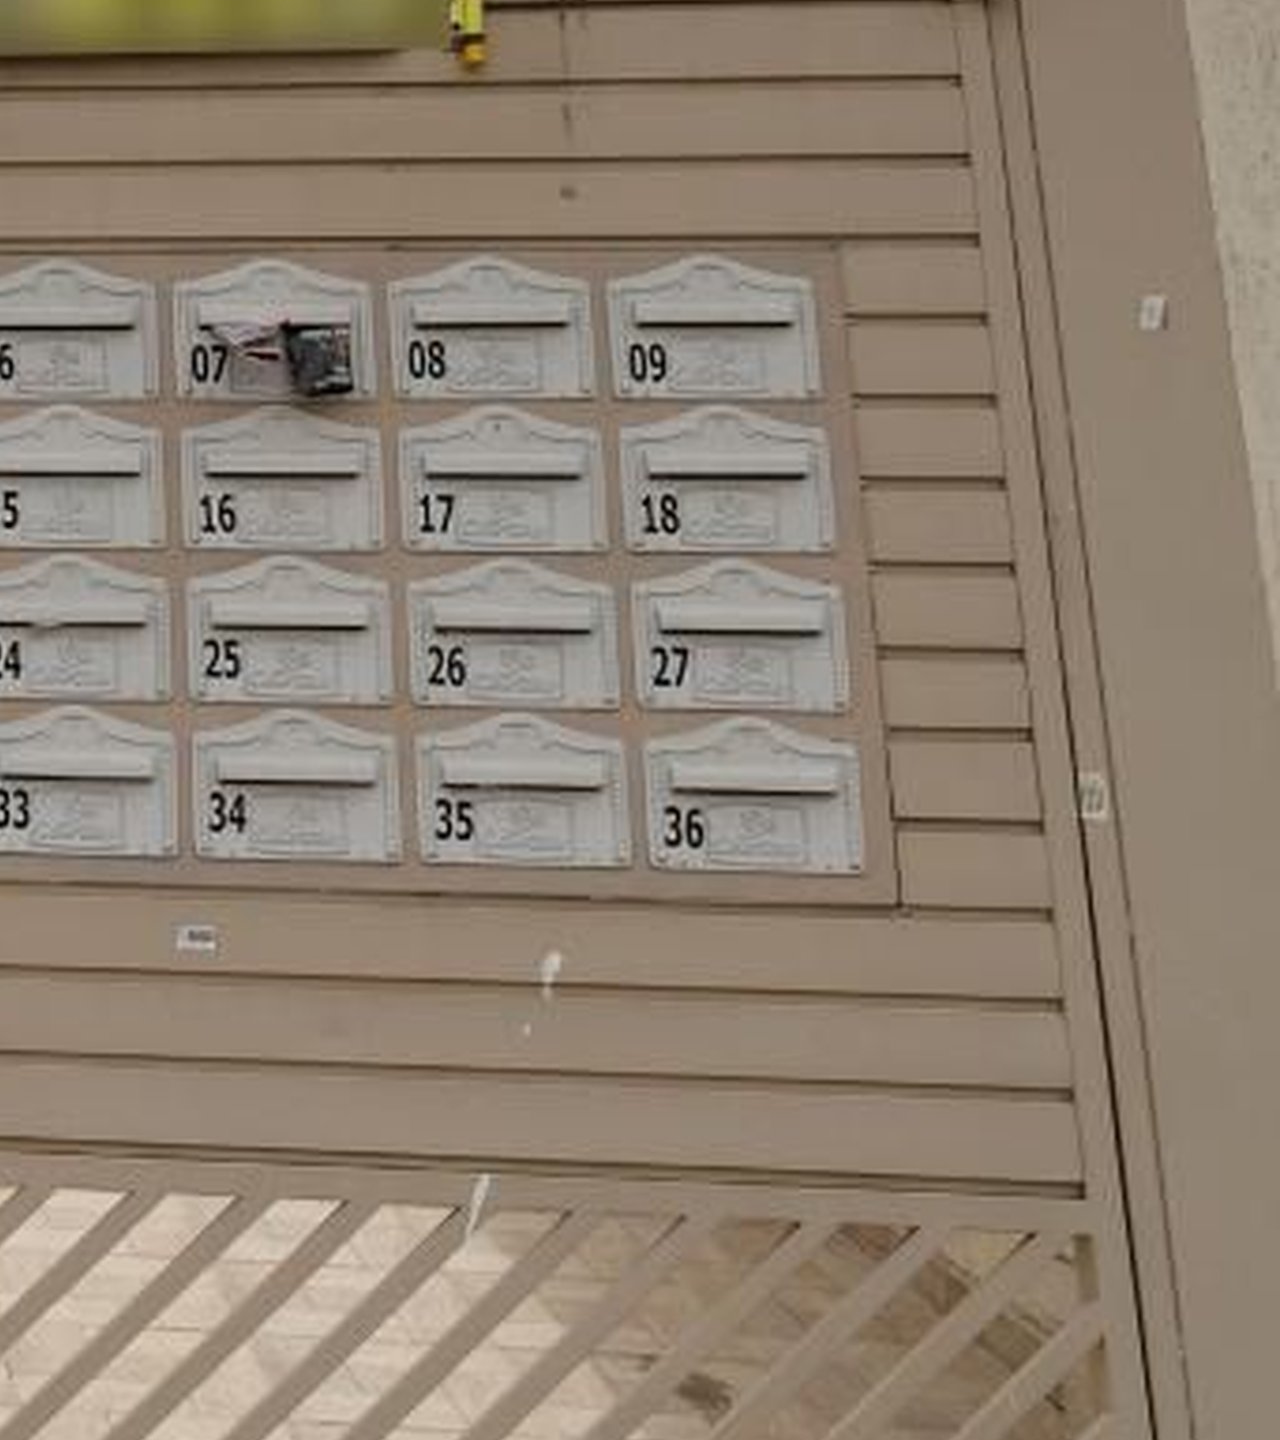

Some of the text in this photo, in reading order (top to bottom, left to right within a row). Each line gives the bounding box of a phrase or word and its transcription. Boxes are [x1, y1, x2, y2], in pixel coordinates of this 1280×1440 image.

[191, 344, 228, 384] 07
[408, 340, 447, 380] 08
[628, 343, 667, 383] 09
[199, 493, 237, 534] 16
[419, 494, 455, 533] 17
[641, 493, 681, 535] 18
[203, 638, 241, 679] 25
[427, 645, 467, 687] 26
[651, 646, 689, 687] 27
[208, 791, 247, 833] 34
[435, 798, 475, 841] 35
[664, 805, 704, 849] 36
